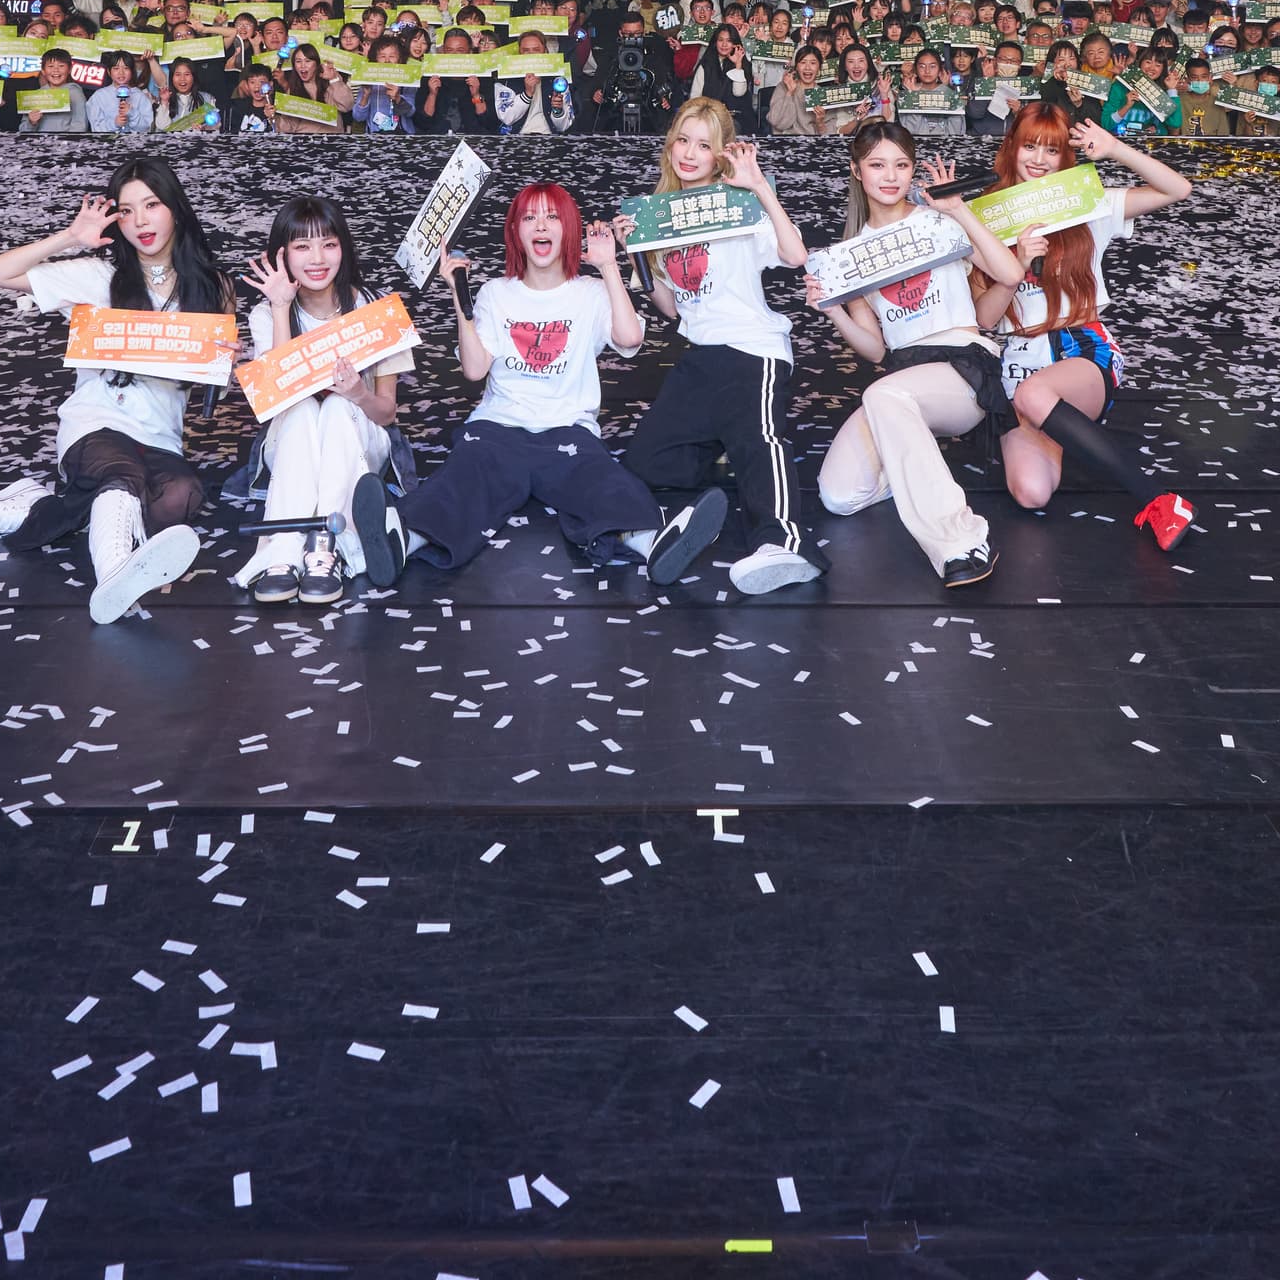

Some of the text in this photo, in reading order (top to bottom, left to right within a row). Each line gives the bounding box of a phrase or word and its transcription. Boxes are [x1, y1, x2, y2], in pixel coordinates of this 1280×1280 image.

[669, 192, 727, 216] 肩並著肩
[982, 203, 1004, 220] 우리
[658, 206, 743, 231] 一起走向未來
[850, 227, 914, 263] 肩並著肩
[843, 238, 935, 280] 一起走向未來
[886, 289, 941, 323] Concert!
[897, 286, 922, 305] Fan
[103, 322, 191, 338] 우리 나란히 하고
[504, 318, 572, 333] SPOILER
[280, 322, 366, 371] 우리 나란히 하고
[526, 346, 552, 361] Fan
[505, 356, 567, 374] Concert!
[112, 821, 141, 851] 1
